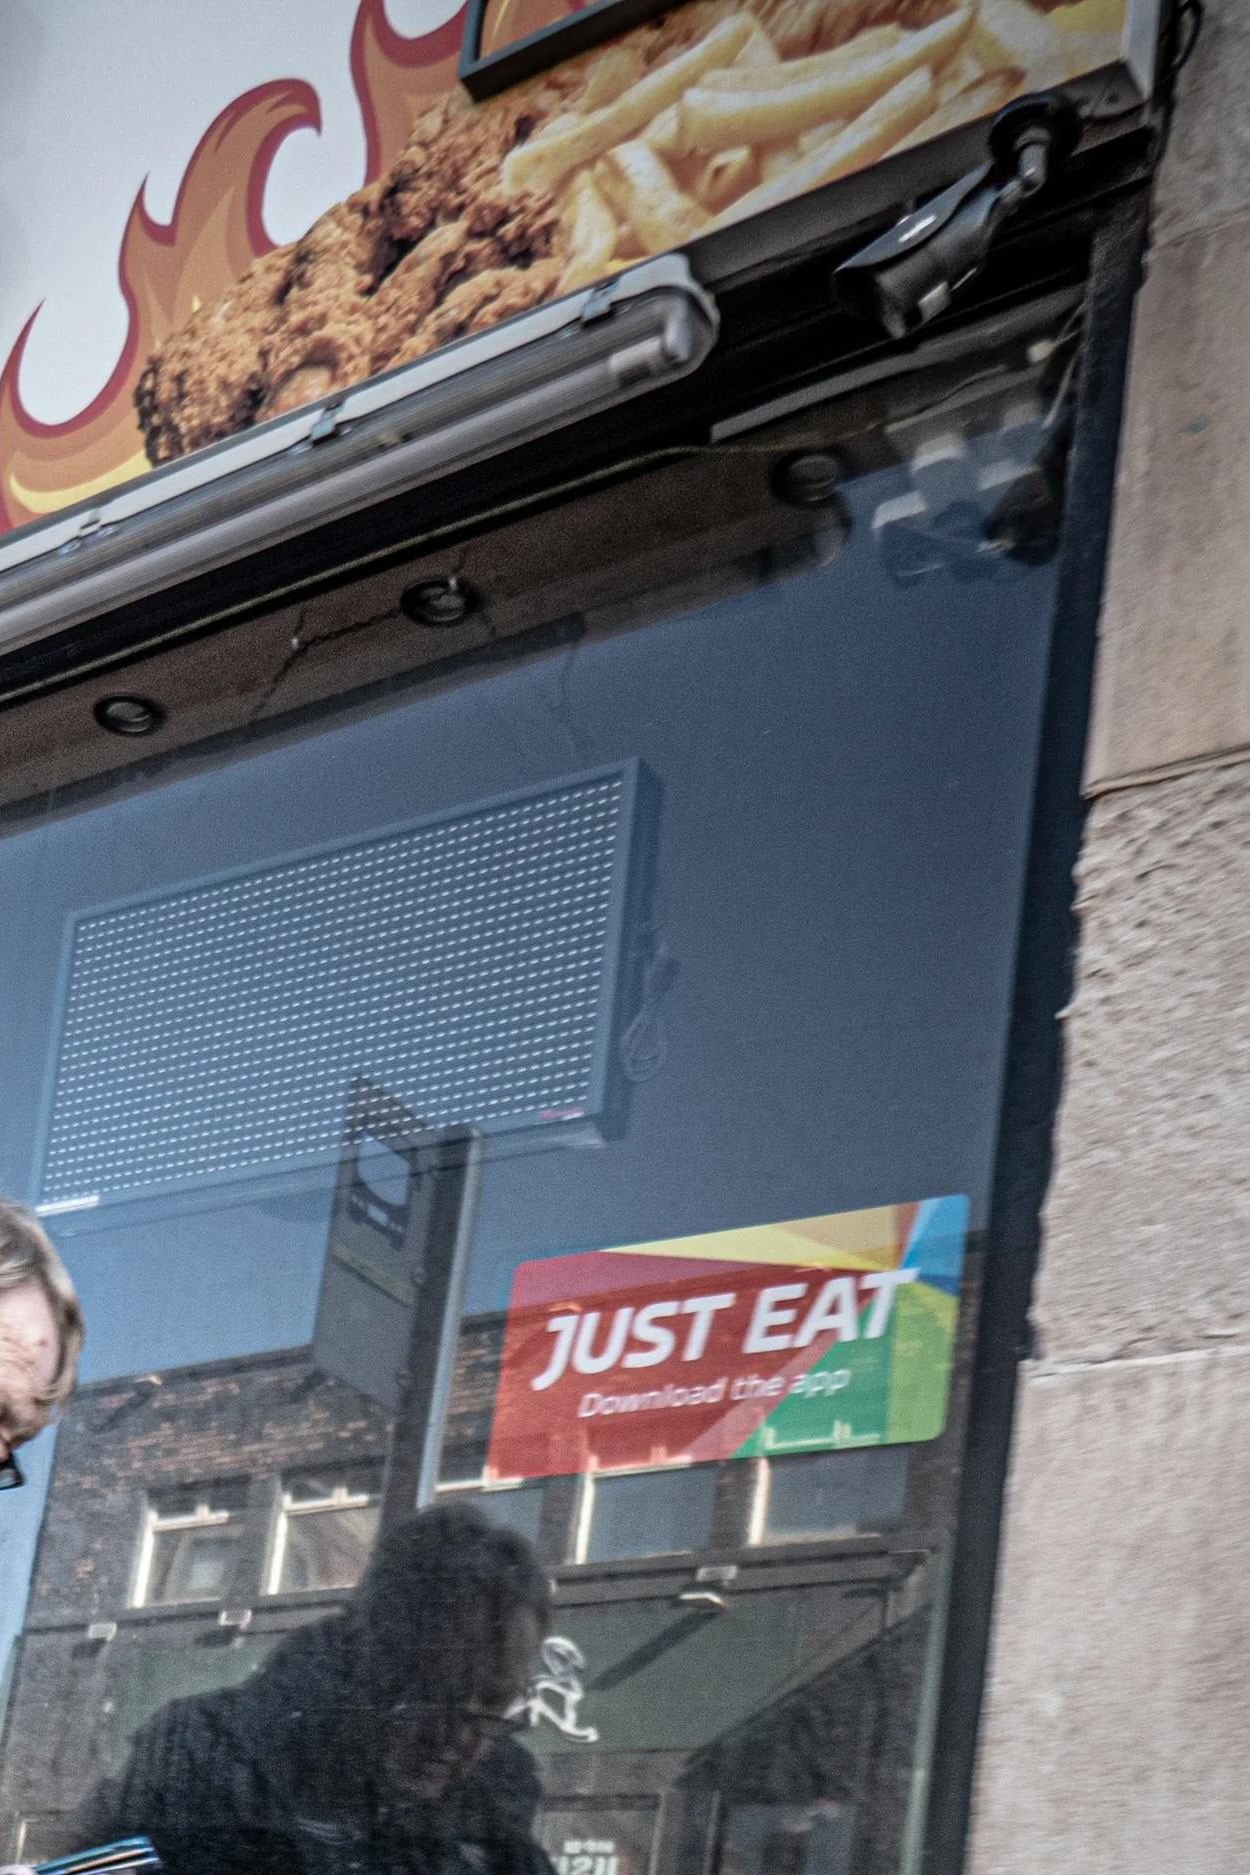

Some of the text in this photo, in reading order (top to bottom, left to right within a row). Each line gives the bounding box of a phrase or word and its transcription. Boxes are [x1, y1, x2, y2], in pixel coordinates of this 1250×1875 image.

[530, 1268, 920, 1391] JUST EAT
[577, 1368, 851, 1418] Download the app
